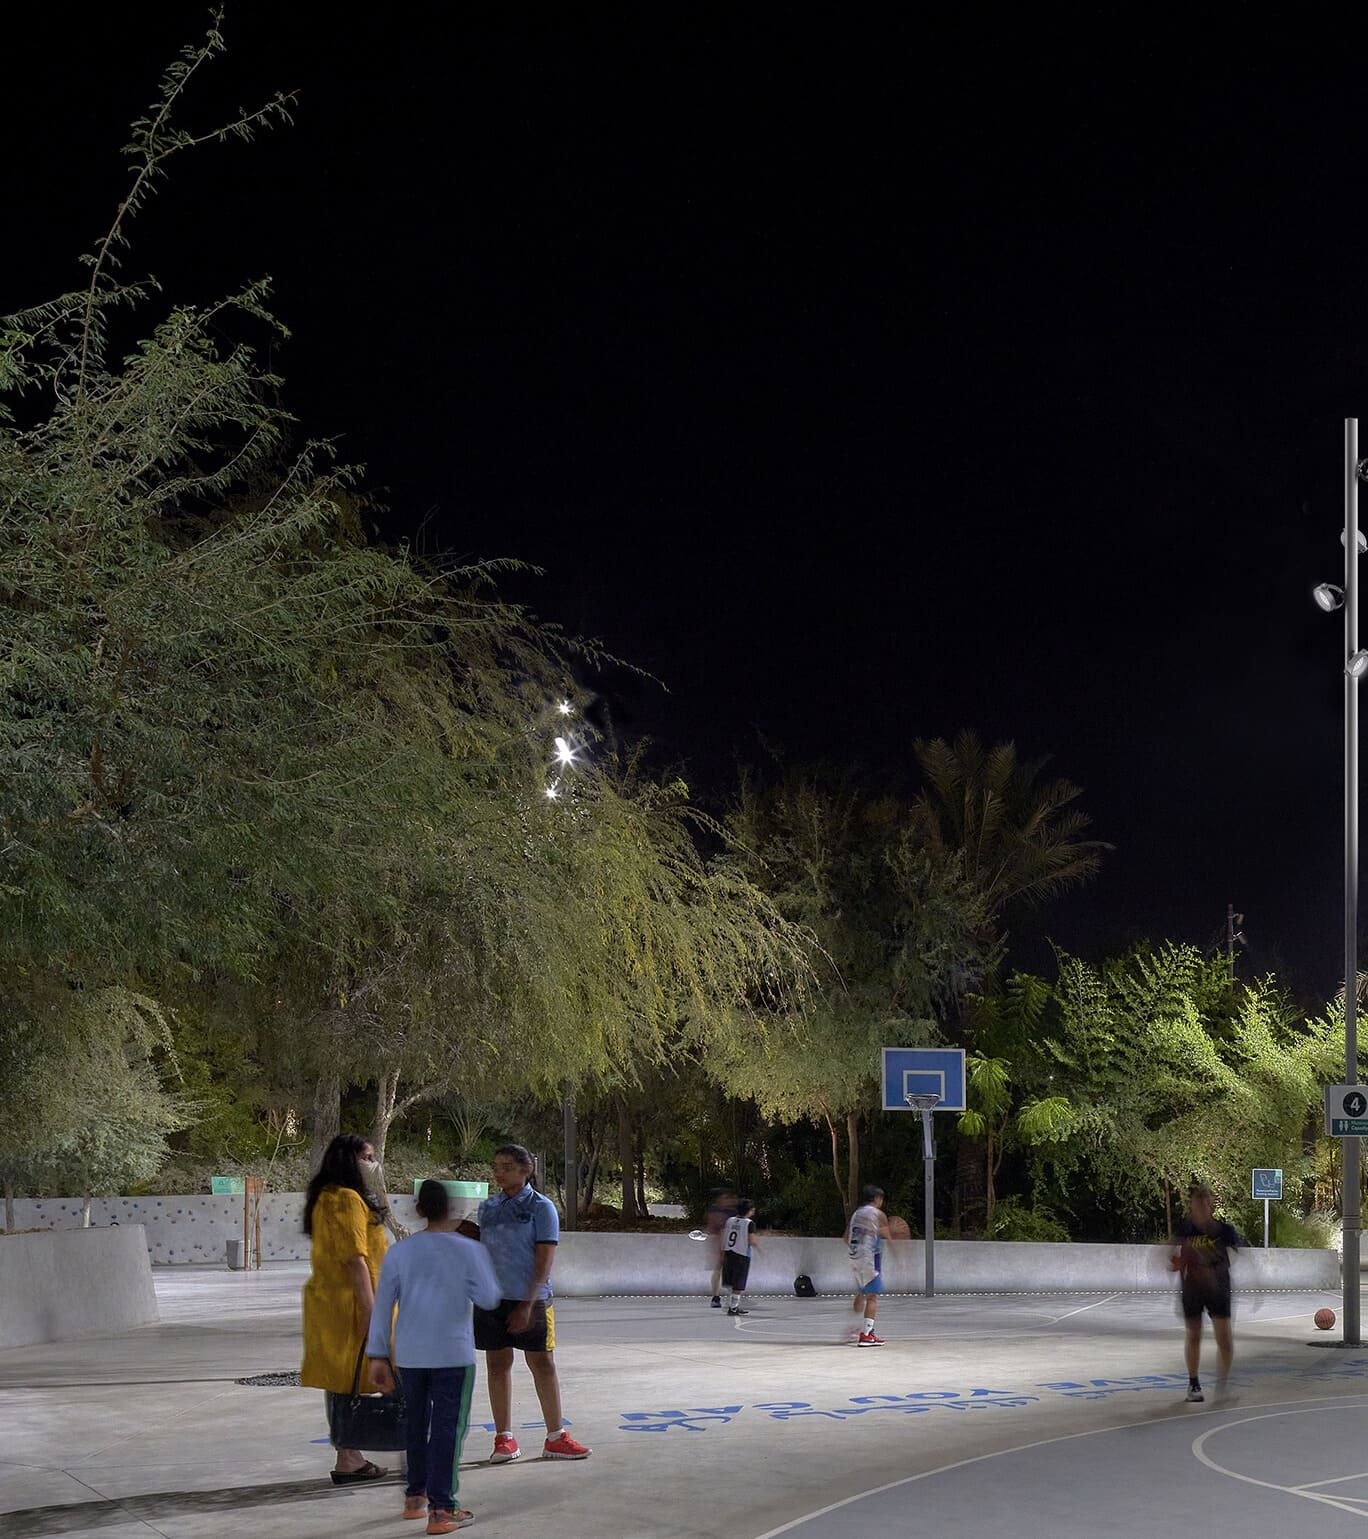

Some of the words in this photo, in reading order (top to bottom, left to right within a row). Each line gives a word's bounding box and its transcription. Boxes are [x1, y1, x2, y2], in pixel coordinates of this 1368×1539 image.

[1351, 1097, 1360, 1111] 4
[728, 1231, 737, 1247] 9
[849, 1388, 1016, 1404] YOU
[621, 1402, 811, 1421] CAN
[618, 1416, 732, 1432] هل
